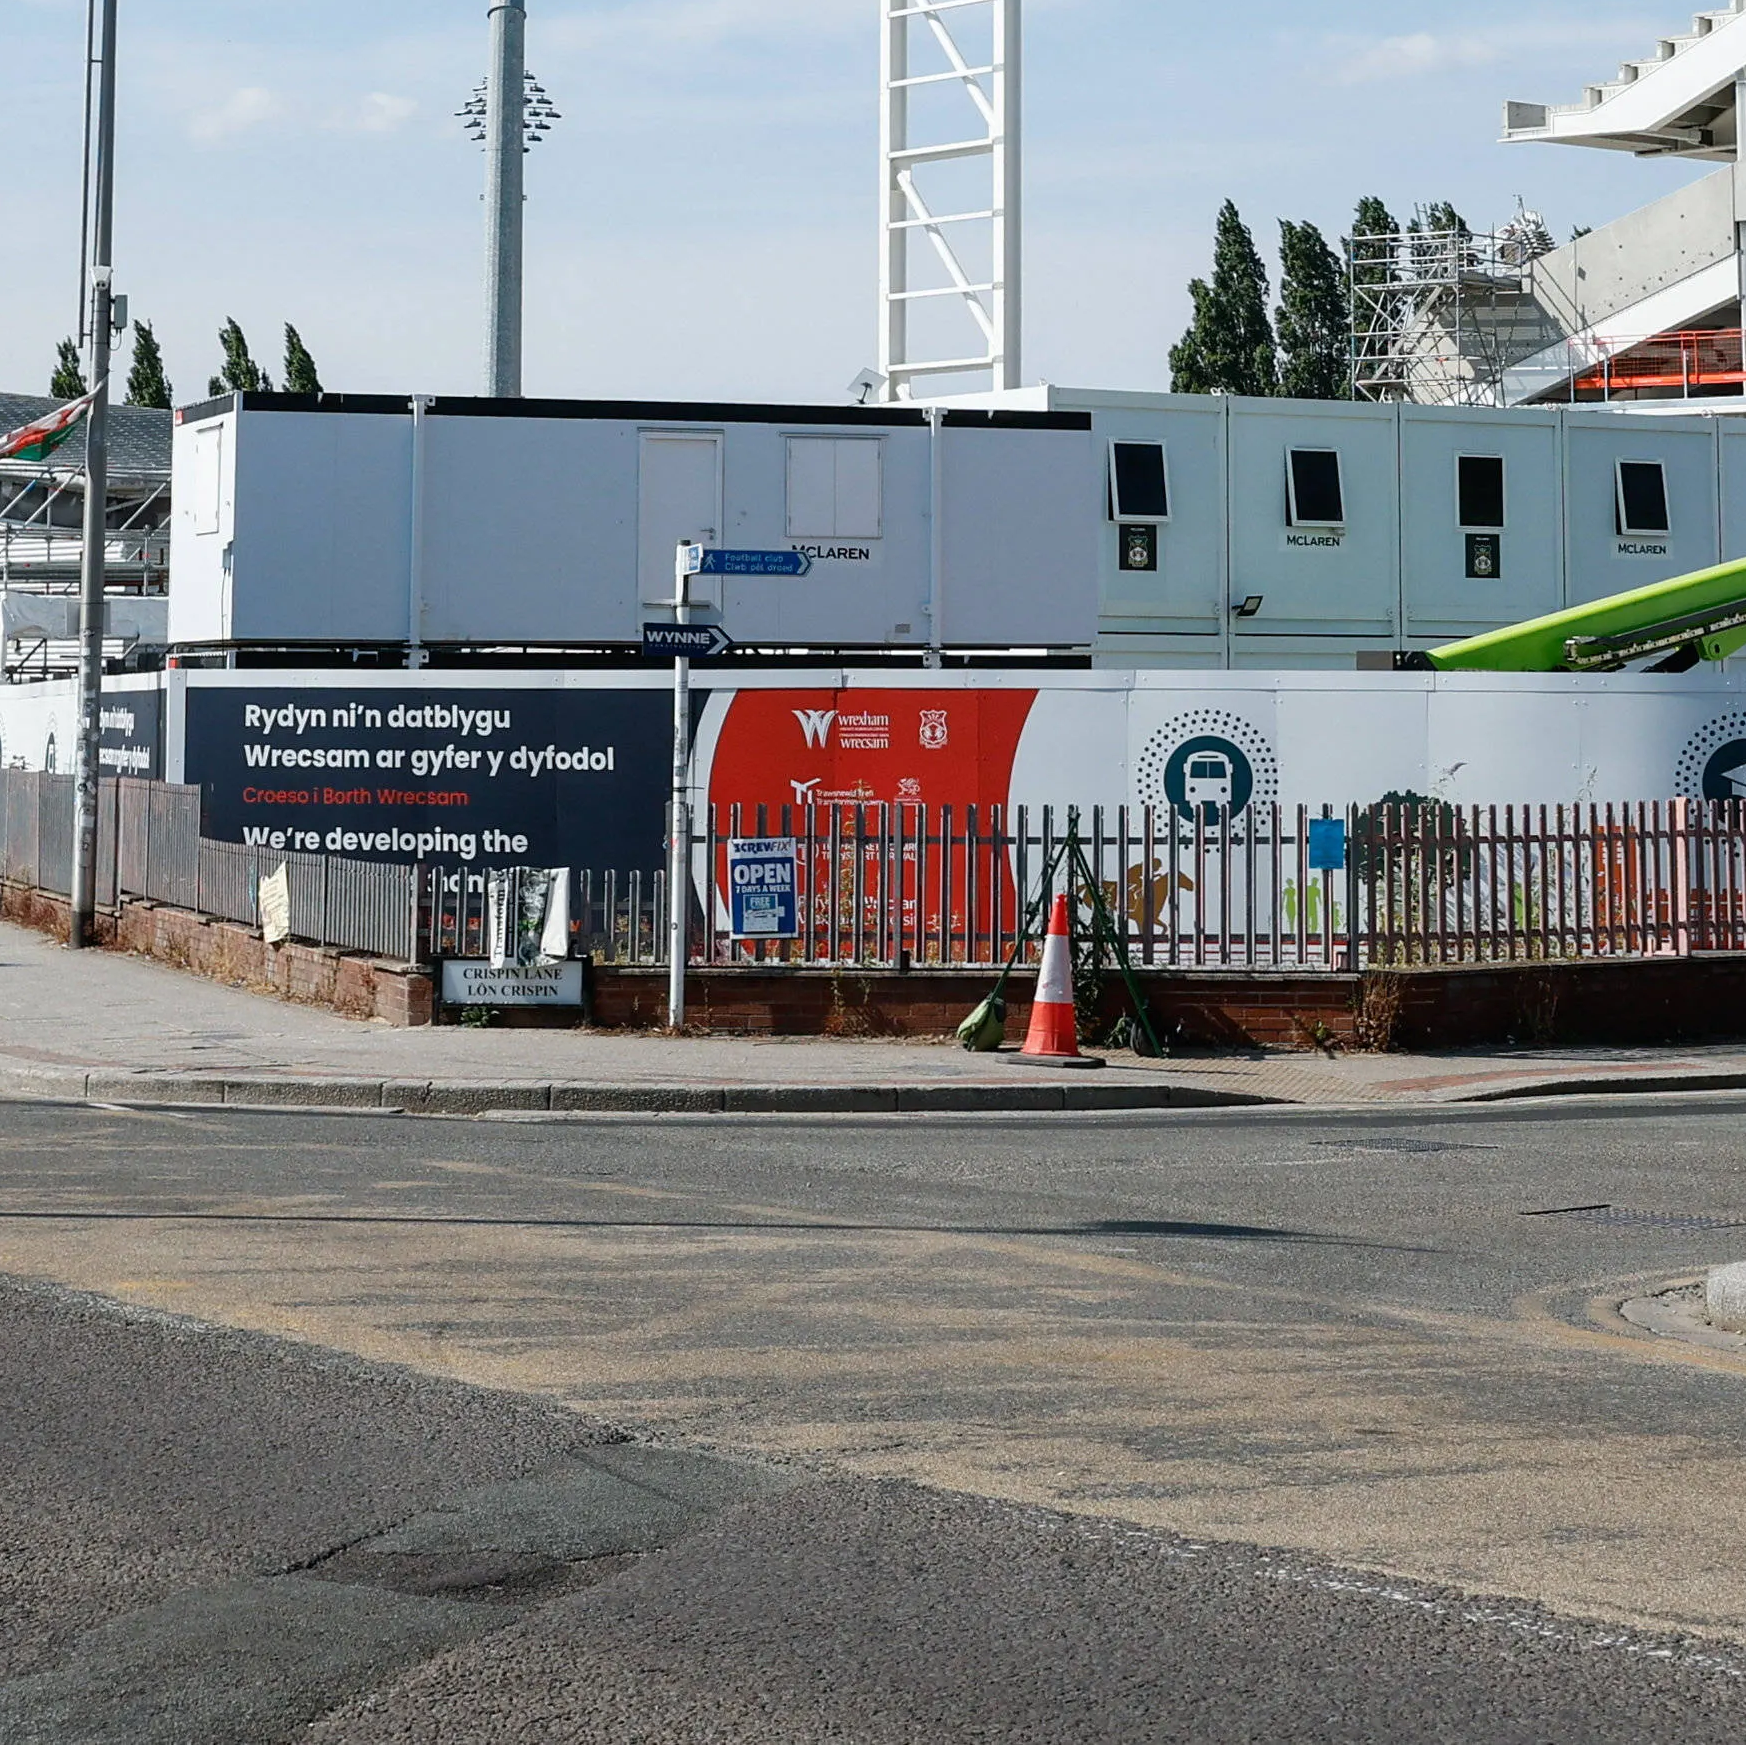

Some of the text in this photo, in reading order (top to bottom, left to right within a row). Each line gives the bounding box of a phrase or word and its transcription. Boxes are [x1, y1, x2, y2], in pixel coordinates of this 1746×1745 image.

[1287, 535, 1340, 546] MCLAREN
[1618, 543, 1667, 554] MCLAREN
[725, 554, 760, 562] Football
[646, 630, 711, 644] WYNNE
[245, 704, 326, 734] Rydyn
[388, 704, 510, 736] datblygu
[838, 711, 889, 726] wrexham
[840, 738, 889, 749] wrecsam
[244, 744, 614, 778] Wrecsam ar gyfer y dyfodol
[243, 787, 469, 806] Croeso i Borth Wrecsam
[325, 826, 476, 860] developing
[482, 829, 528, 853] the
[734, 841, 791, 853] SCREWFIX
[734, 863, 791, 885] OPEN
[736, 885, 791, 894] 7 DAYS A WEEK
[463, 967, 563, 980] CRISPIN LANE
[467, 983, 558, 997] LÔN CRISPIN
